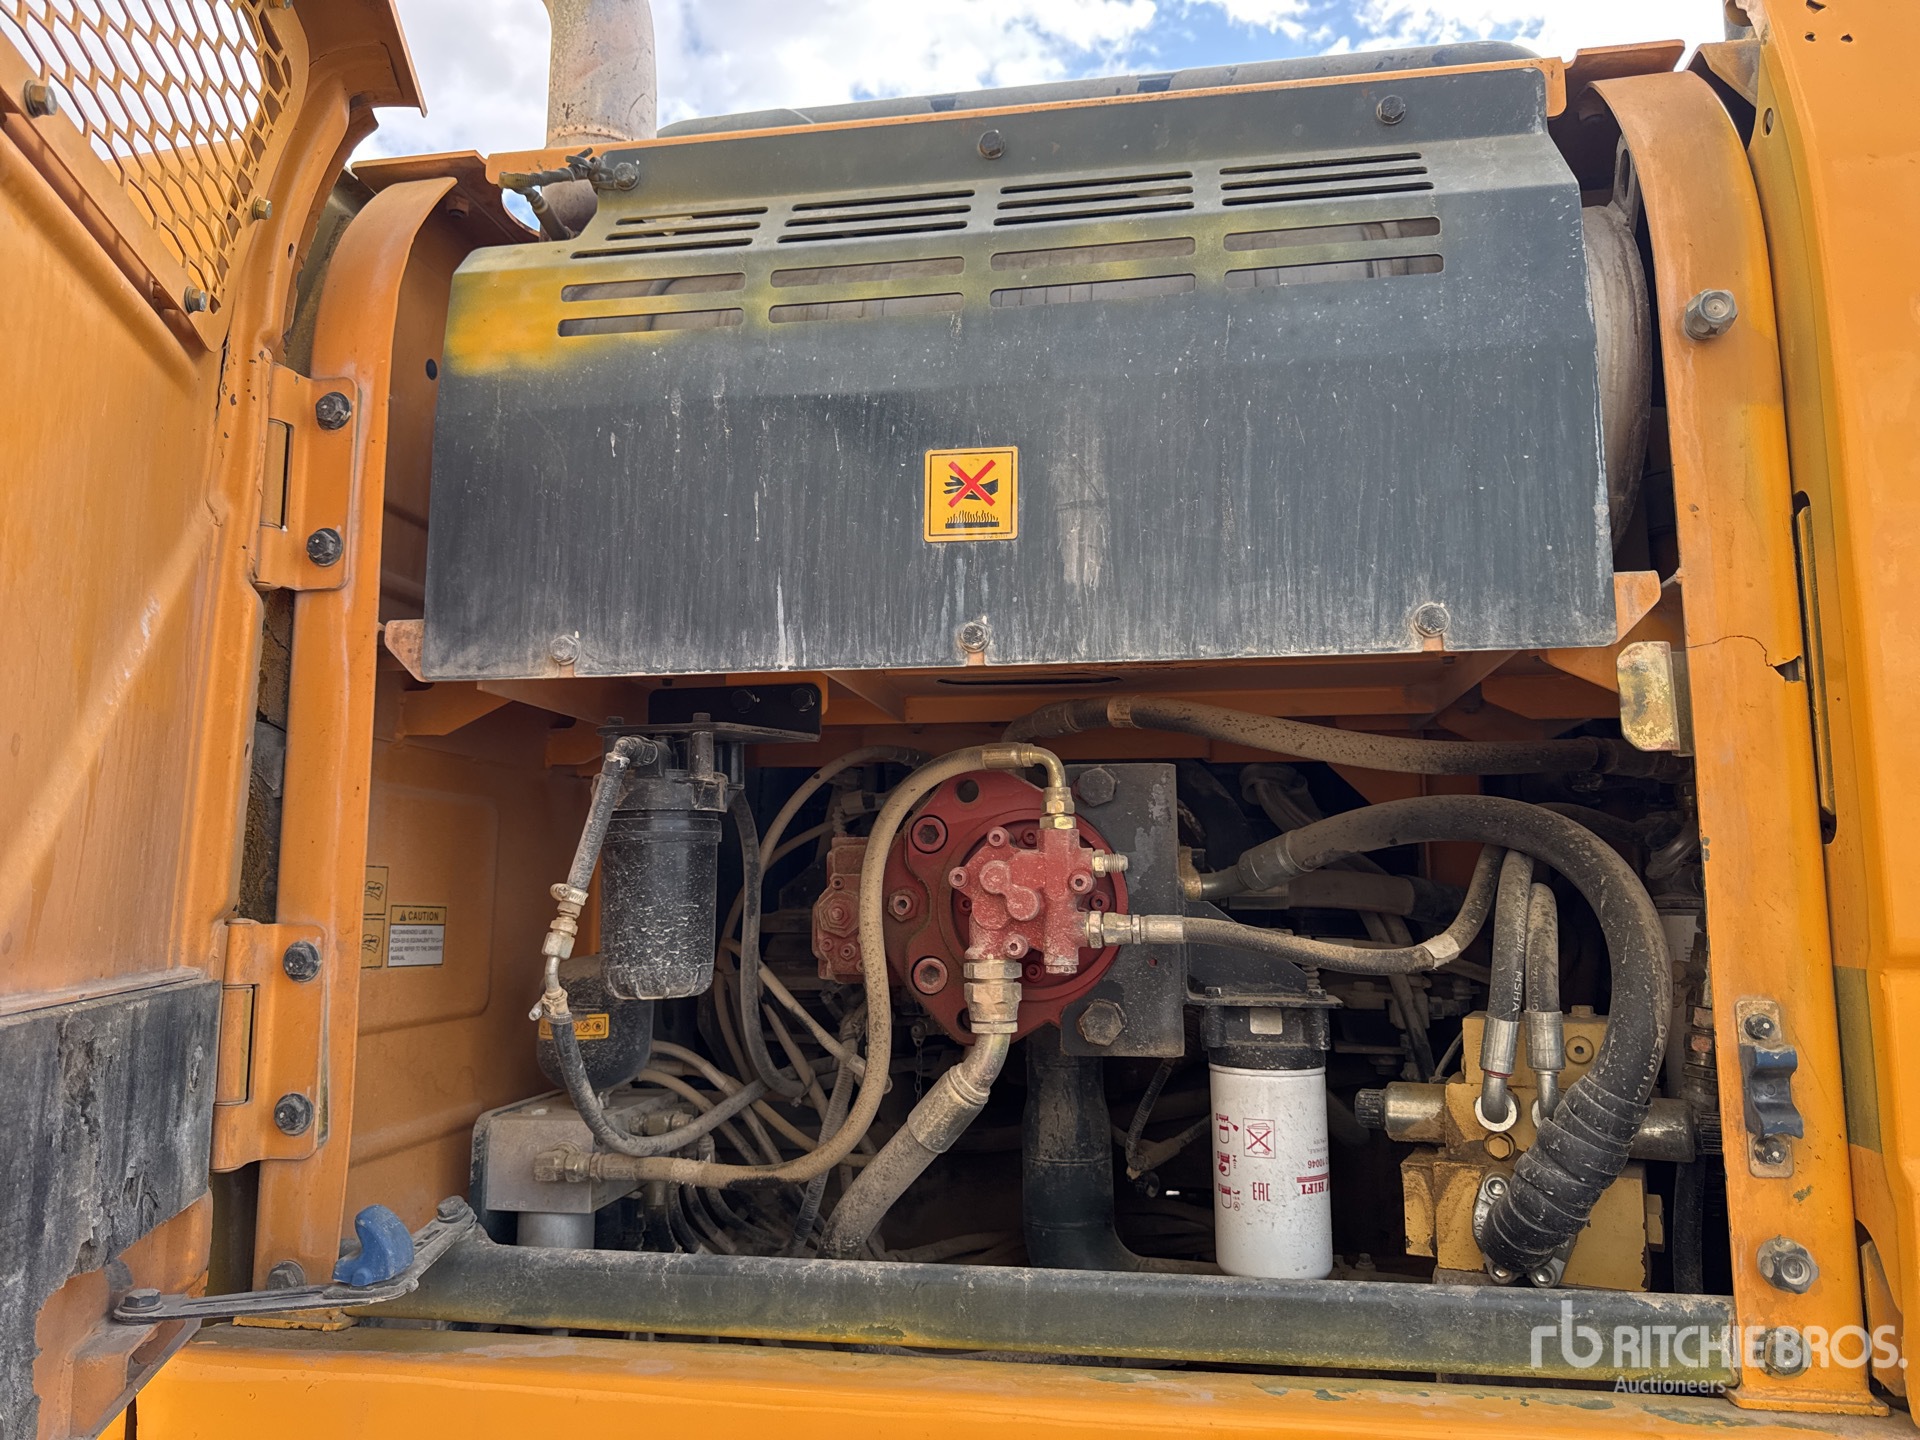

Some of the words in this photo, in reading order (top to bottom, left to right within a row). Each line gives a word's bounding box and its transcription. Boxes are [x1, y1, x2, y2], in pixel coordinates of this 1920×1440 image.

[408, 911, 439, 921] CAUTION
[1511, 970, 1524, 1012] MSHA
[1307, 1158, 1325, 1169] 10046
[1252, 1181, 1271, 1202] EAC
[1301, 1182, 1325, 1195] HIFI
